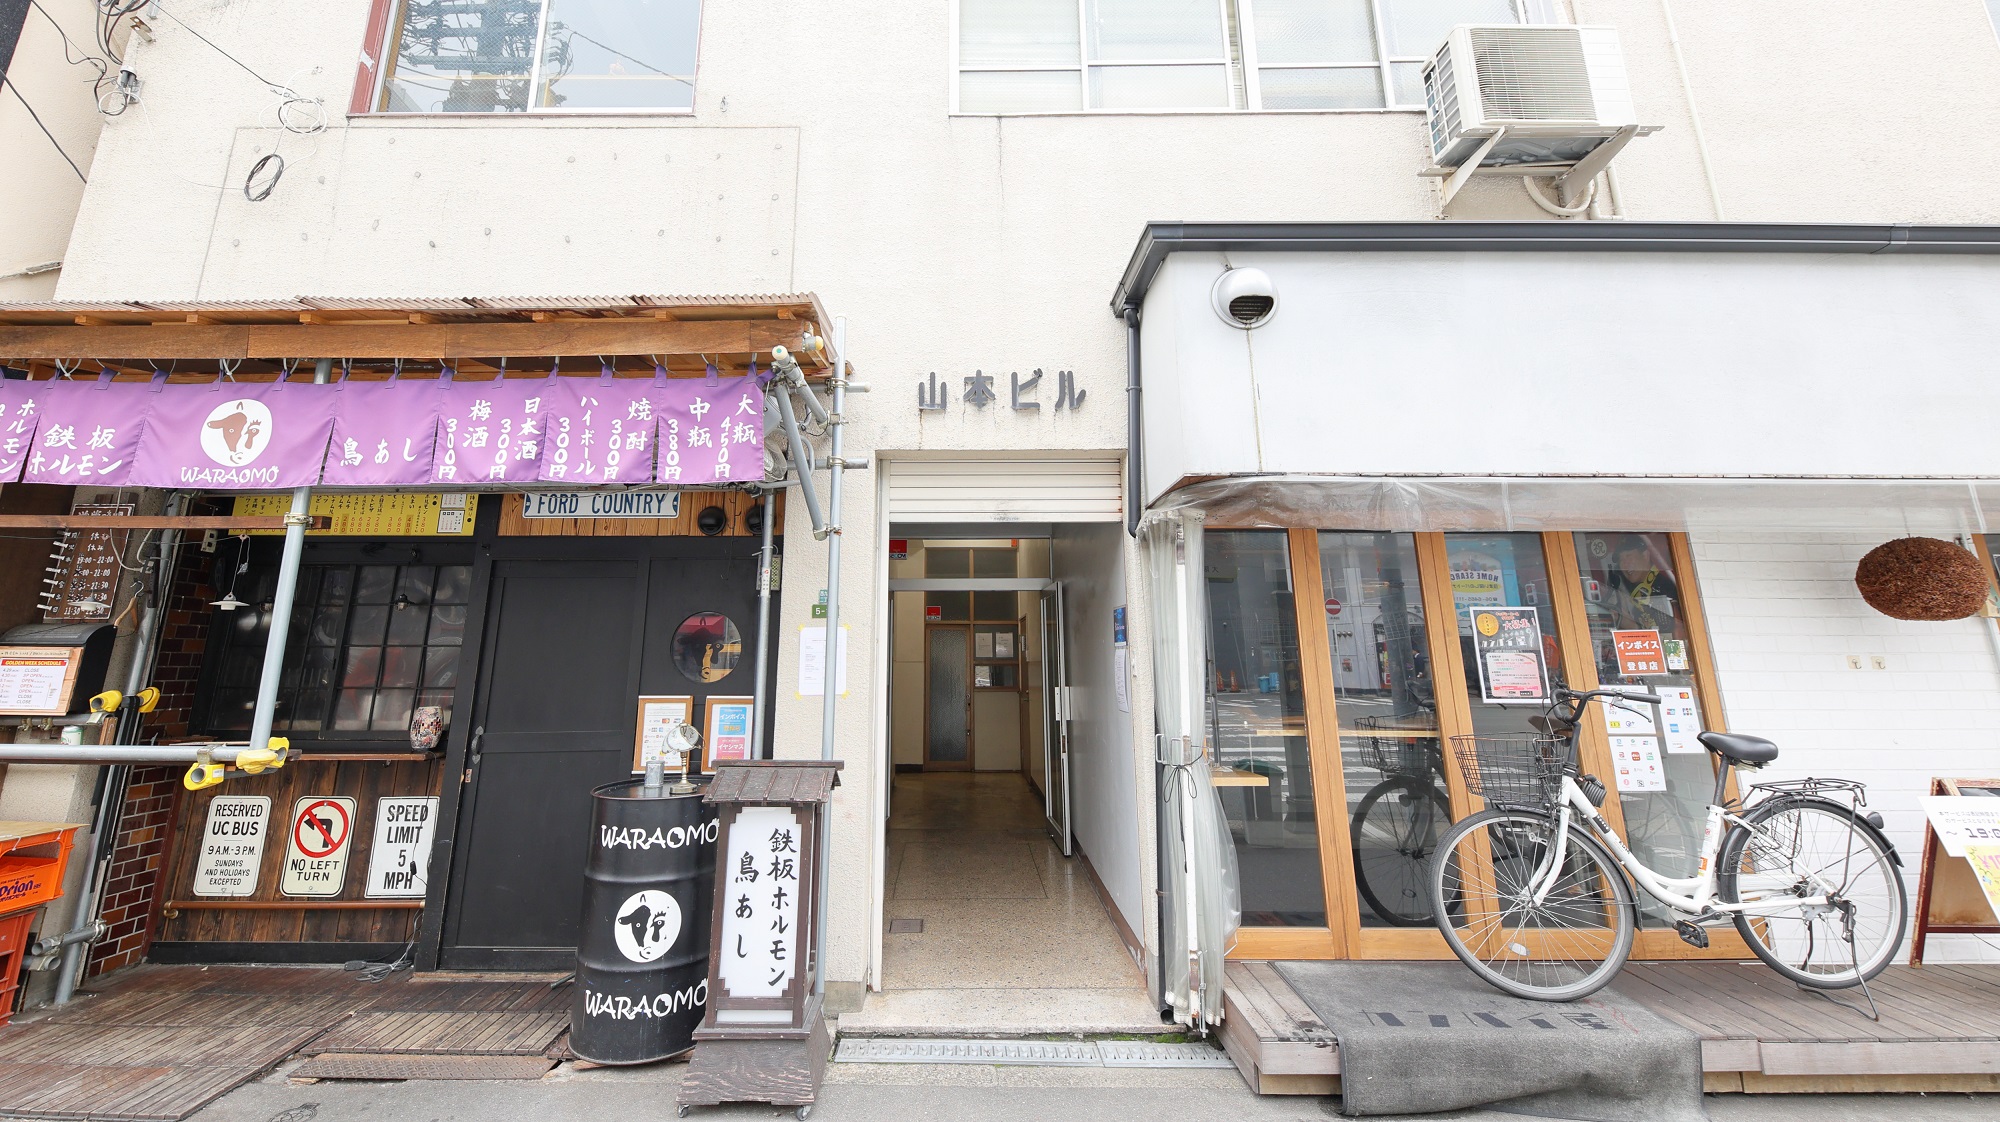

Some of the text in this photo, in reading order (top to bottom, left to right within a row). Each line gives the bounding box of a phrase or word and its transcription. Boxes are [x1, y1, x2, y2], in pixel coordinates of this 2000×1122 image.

[918, 368, 1087, 411] 山本ビル
[462, 399, 492, 448] 梅酒
[513, 397, 541, 460] 日本酒
[626, 397, 652, 451] 焼酎
[688, 397, 712, 448] 中瓶
[732, 393, 758, 445] 大瓶
[44, 424, 116, 450] 鉄板
[489, 418, 512, 479] 300円
[549, 417, 571, 478] 300円
[574, 396, 599, 476] ハイボール
[603, 419, 622, 480] 300円
[665, 418, 682, 480] 380円
[715, 416, 732, 479] 450円
[28, 451, 123, 476] ホルモン
[340, 437, 418, 467] 鳥あし
[180, 466, 280, 484] WARAOMO
[537, 492, 666, 514] FORD COUNTRY
[1617, 640, 1660, 650] インボイス
[1626, 660, 1659, 671] 登録店
[215, 804, 263, 817] RESERVED
[387, 804, 428, 822] SPEED
[212, 822, 259, 835] UC BUS
[386, 826, 423, 844] LIMIT
[600, 817, 720, 851] WARAOMO
[214, 859, 244, 868] SUNDAYS
[291, 858, 340, 871] NO LEFT
[398, 849, 406, 867] 5
[209, 878, 242, 886] EXCEPTED
[219, 869, 250, 877] HOLIDAYS
[297, 872, 330, 882] TURN
[383, 872, 413, 890] MPH
[734, 850, 760, 959] 鳥あし
[767, 828, 797, 987] 鉄板ホルモン
[585, 977, 709, 1021] WARAOMO
